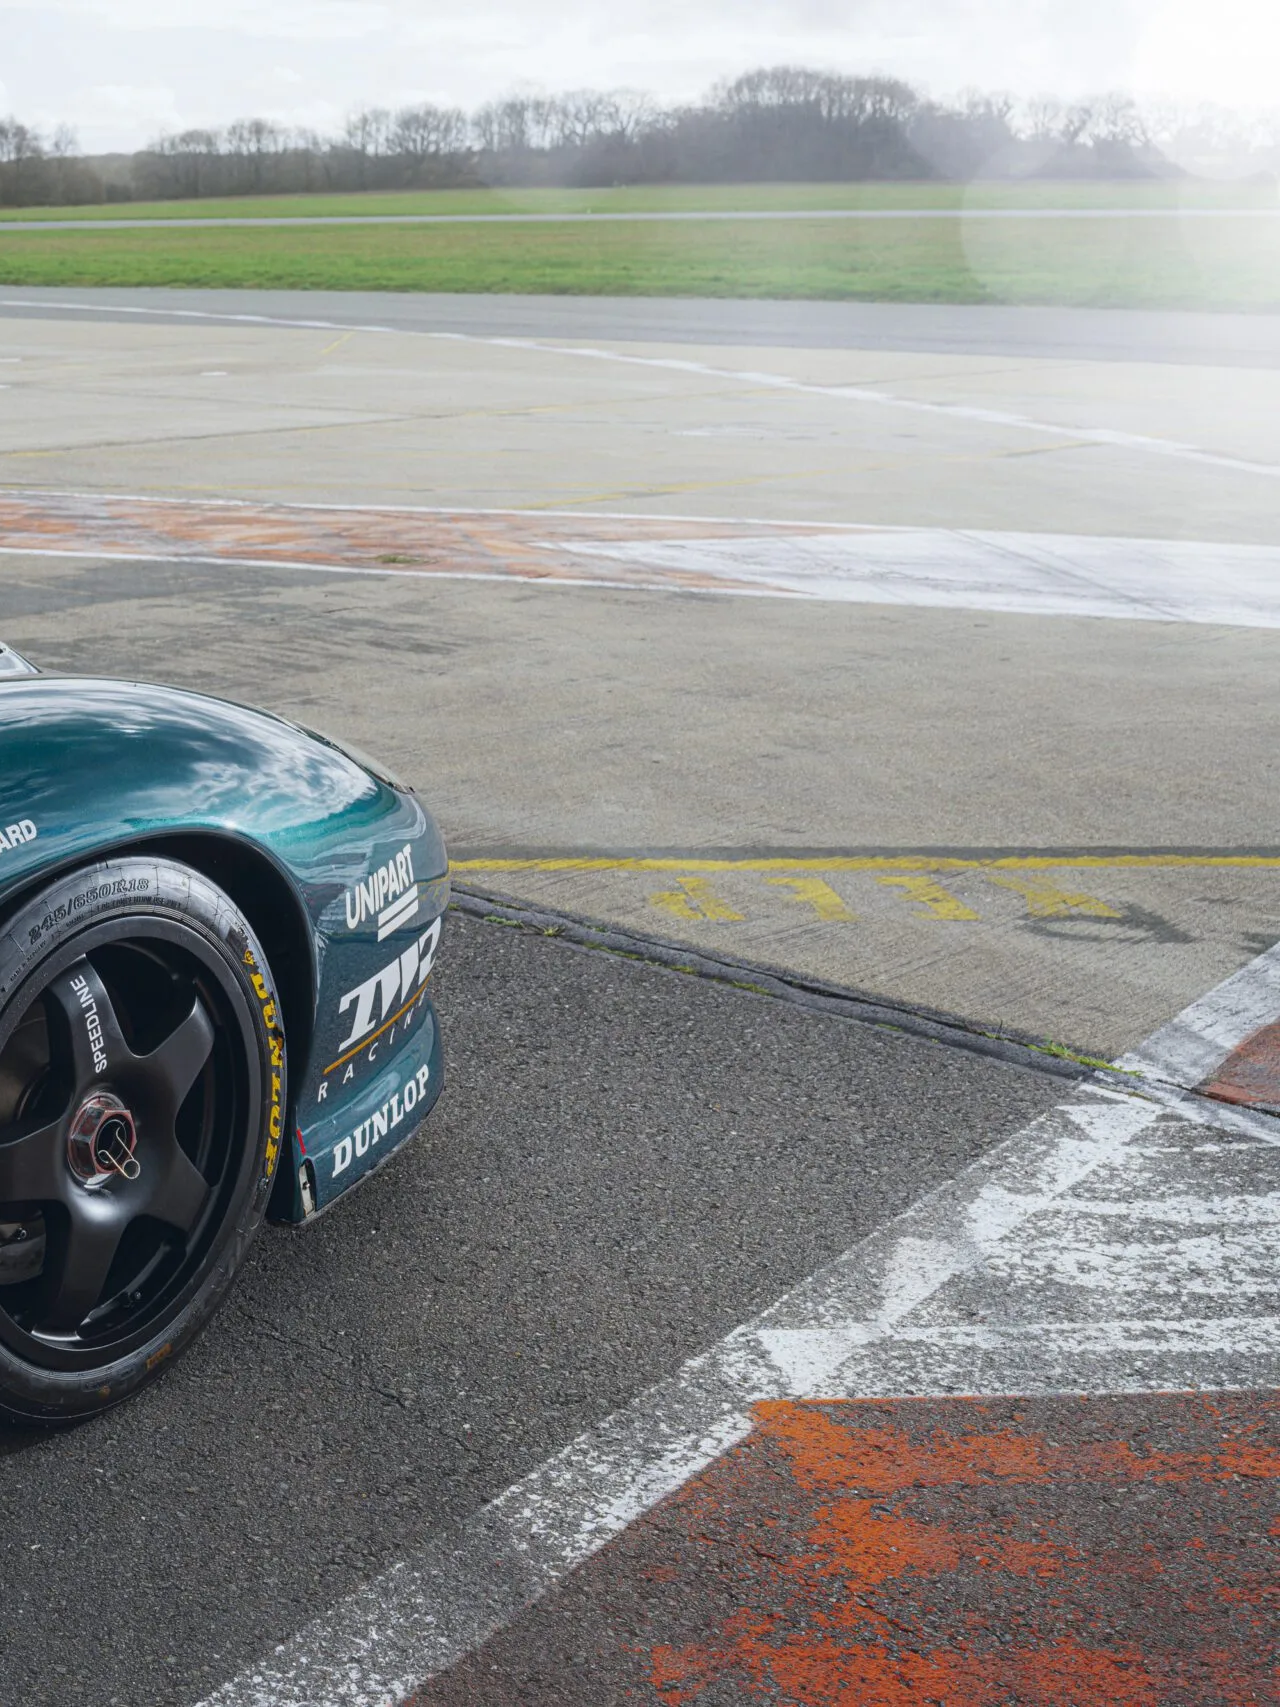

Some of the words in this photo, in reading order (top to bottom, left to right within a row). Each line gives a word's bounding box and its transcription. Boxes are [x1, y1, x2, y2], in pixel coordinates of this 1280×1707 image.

[28, 878, 150, 945] 245/650R18
[345, 843, 414, 930] UNIPART
[69, 974, 108, 1074] SPEEDLINE
[337, 915, 442, 1054] TWR
[331, 1063, 430, 1178] DUNLOP
